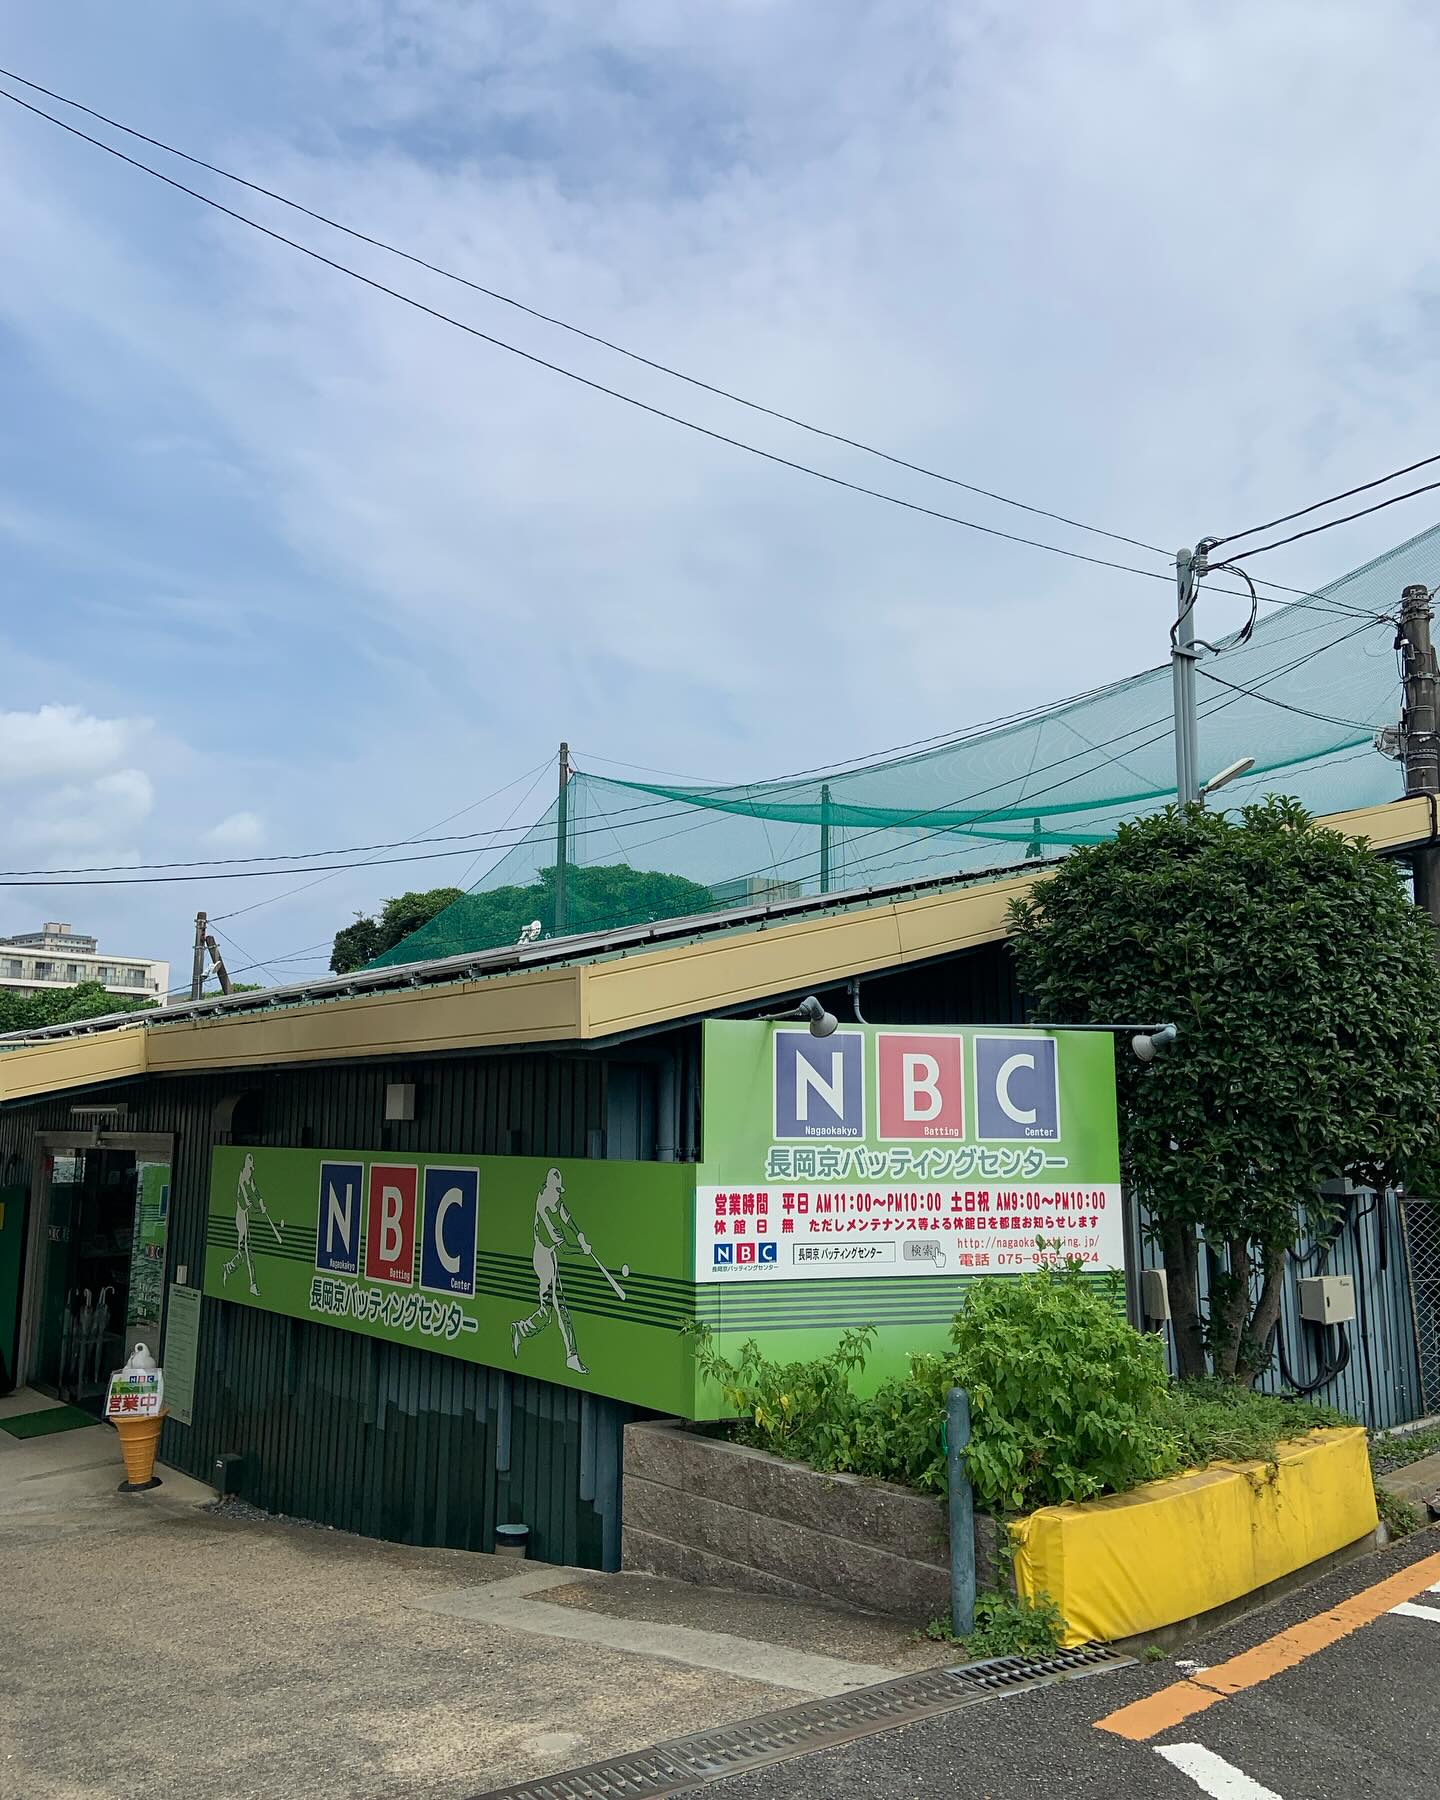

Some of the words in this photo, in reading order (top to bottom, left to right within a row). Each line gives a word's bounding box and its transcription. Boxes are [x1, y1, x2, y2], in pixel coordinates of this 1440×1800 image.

[805, 1126, 858, 1136] Nagaokakyo
[924, 1126, 959, 1137] Batting
[1024, 1127, 1054, 1137] Center
[766, 1147, 1067, 1180] 長岡京バッティングセンター
[714, 1192, 769, 1216] 営業時間
[782, 1193, 809, 1215] 平日
[950, 1191, 990, 1212] 土日祝
[911, 1244, 933, 1257] 検索
[959, 1252, 990, 1267] 電話
[389, 1268, 411, 1282] Batting
[450, 1277, 472, 1291] Center
[310, 1277, 478, 1337] 長岡京バッティングセンター
[109, 1394, 157, 1412] 営業中
